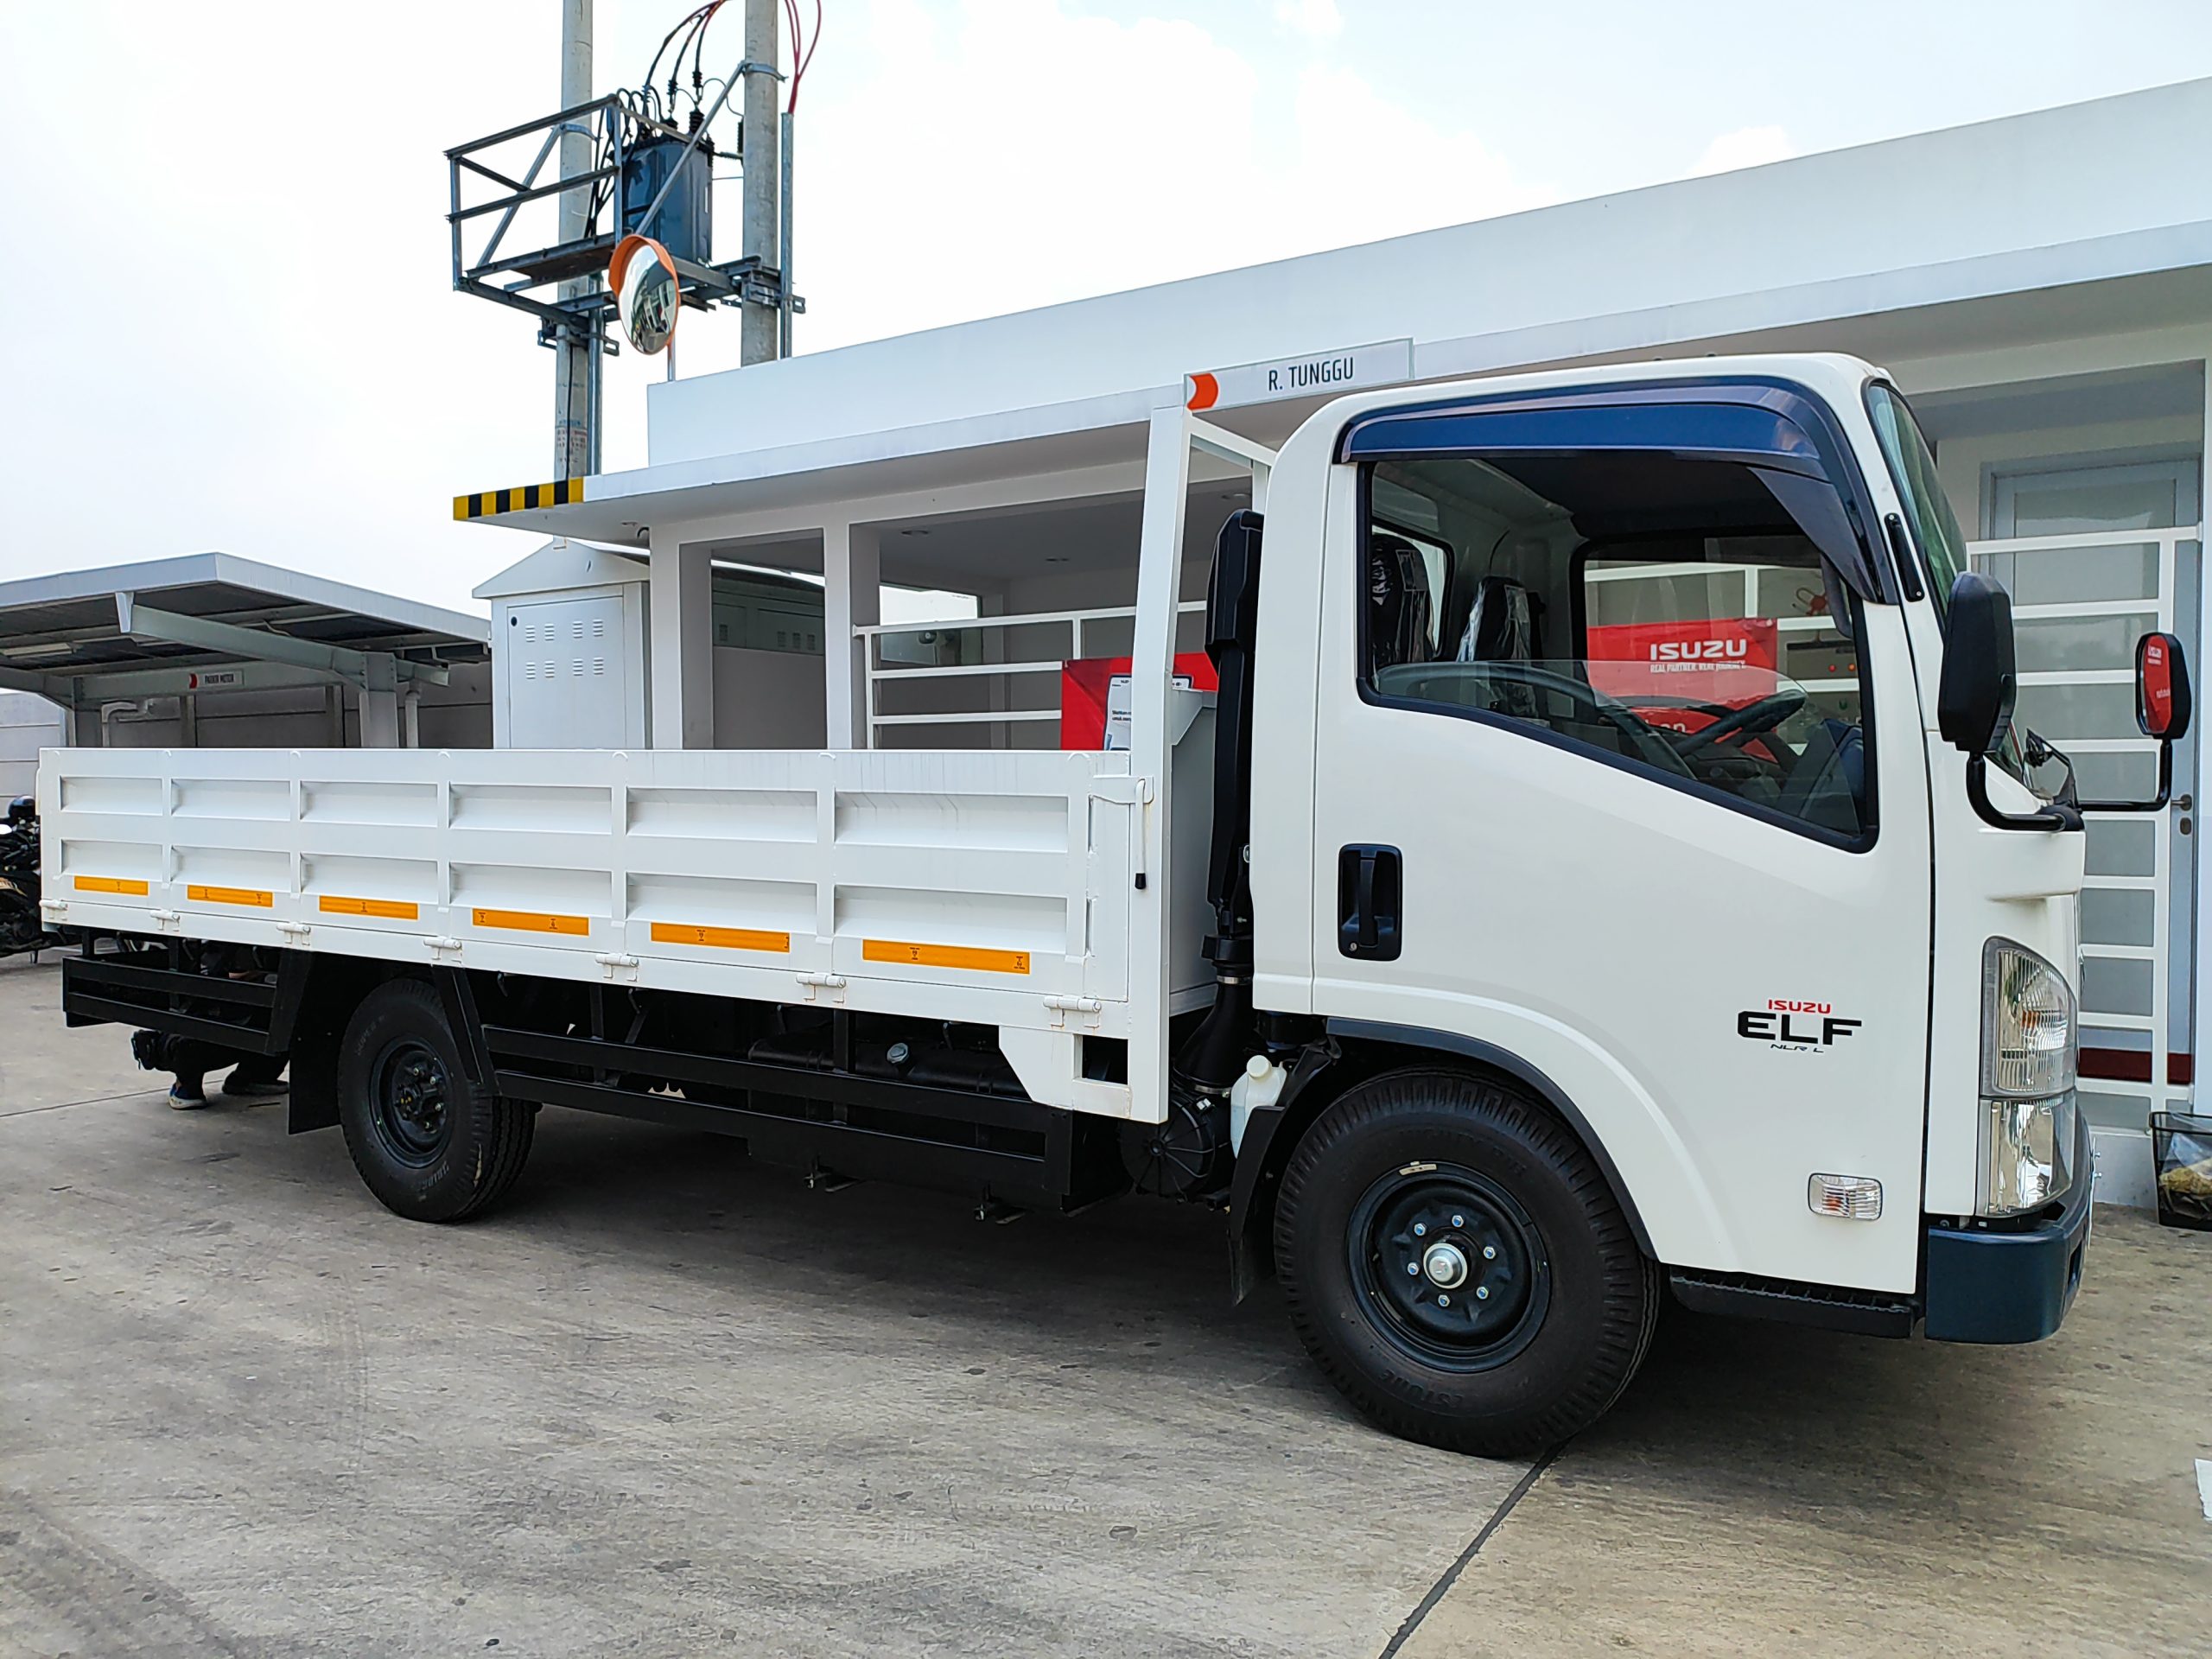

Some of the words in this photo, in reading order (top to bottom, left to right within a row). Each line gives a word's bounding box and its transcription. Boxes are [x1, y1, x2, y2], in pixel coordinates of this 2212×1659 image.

[1268, 369, 1283, 391] R.
[1288, 357, 1354, 388] TUNGGU
[1650, 639, 1747, 660] ISUZU
[1768, 999, 1831, 1014] ISUZU
[1737, 1010, 1862, 1046] ELF
